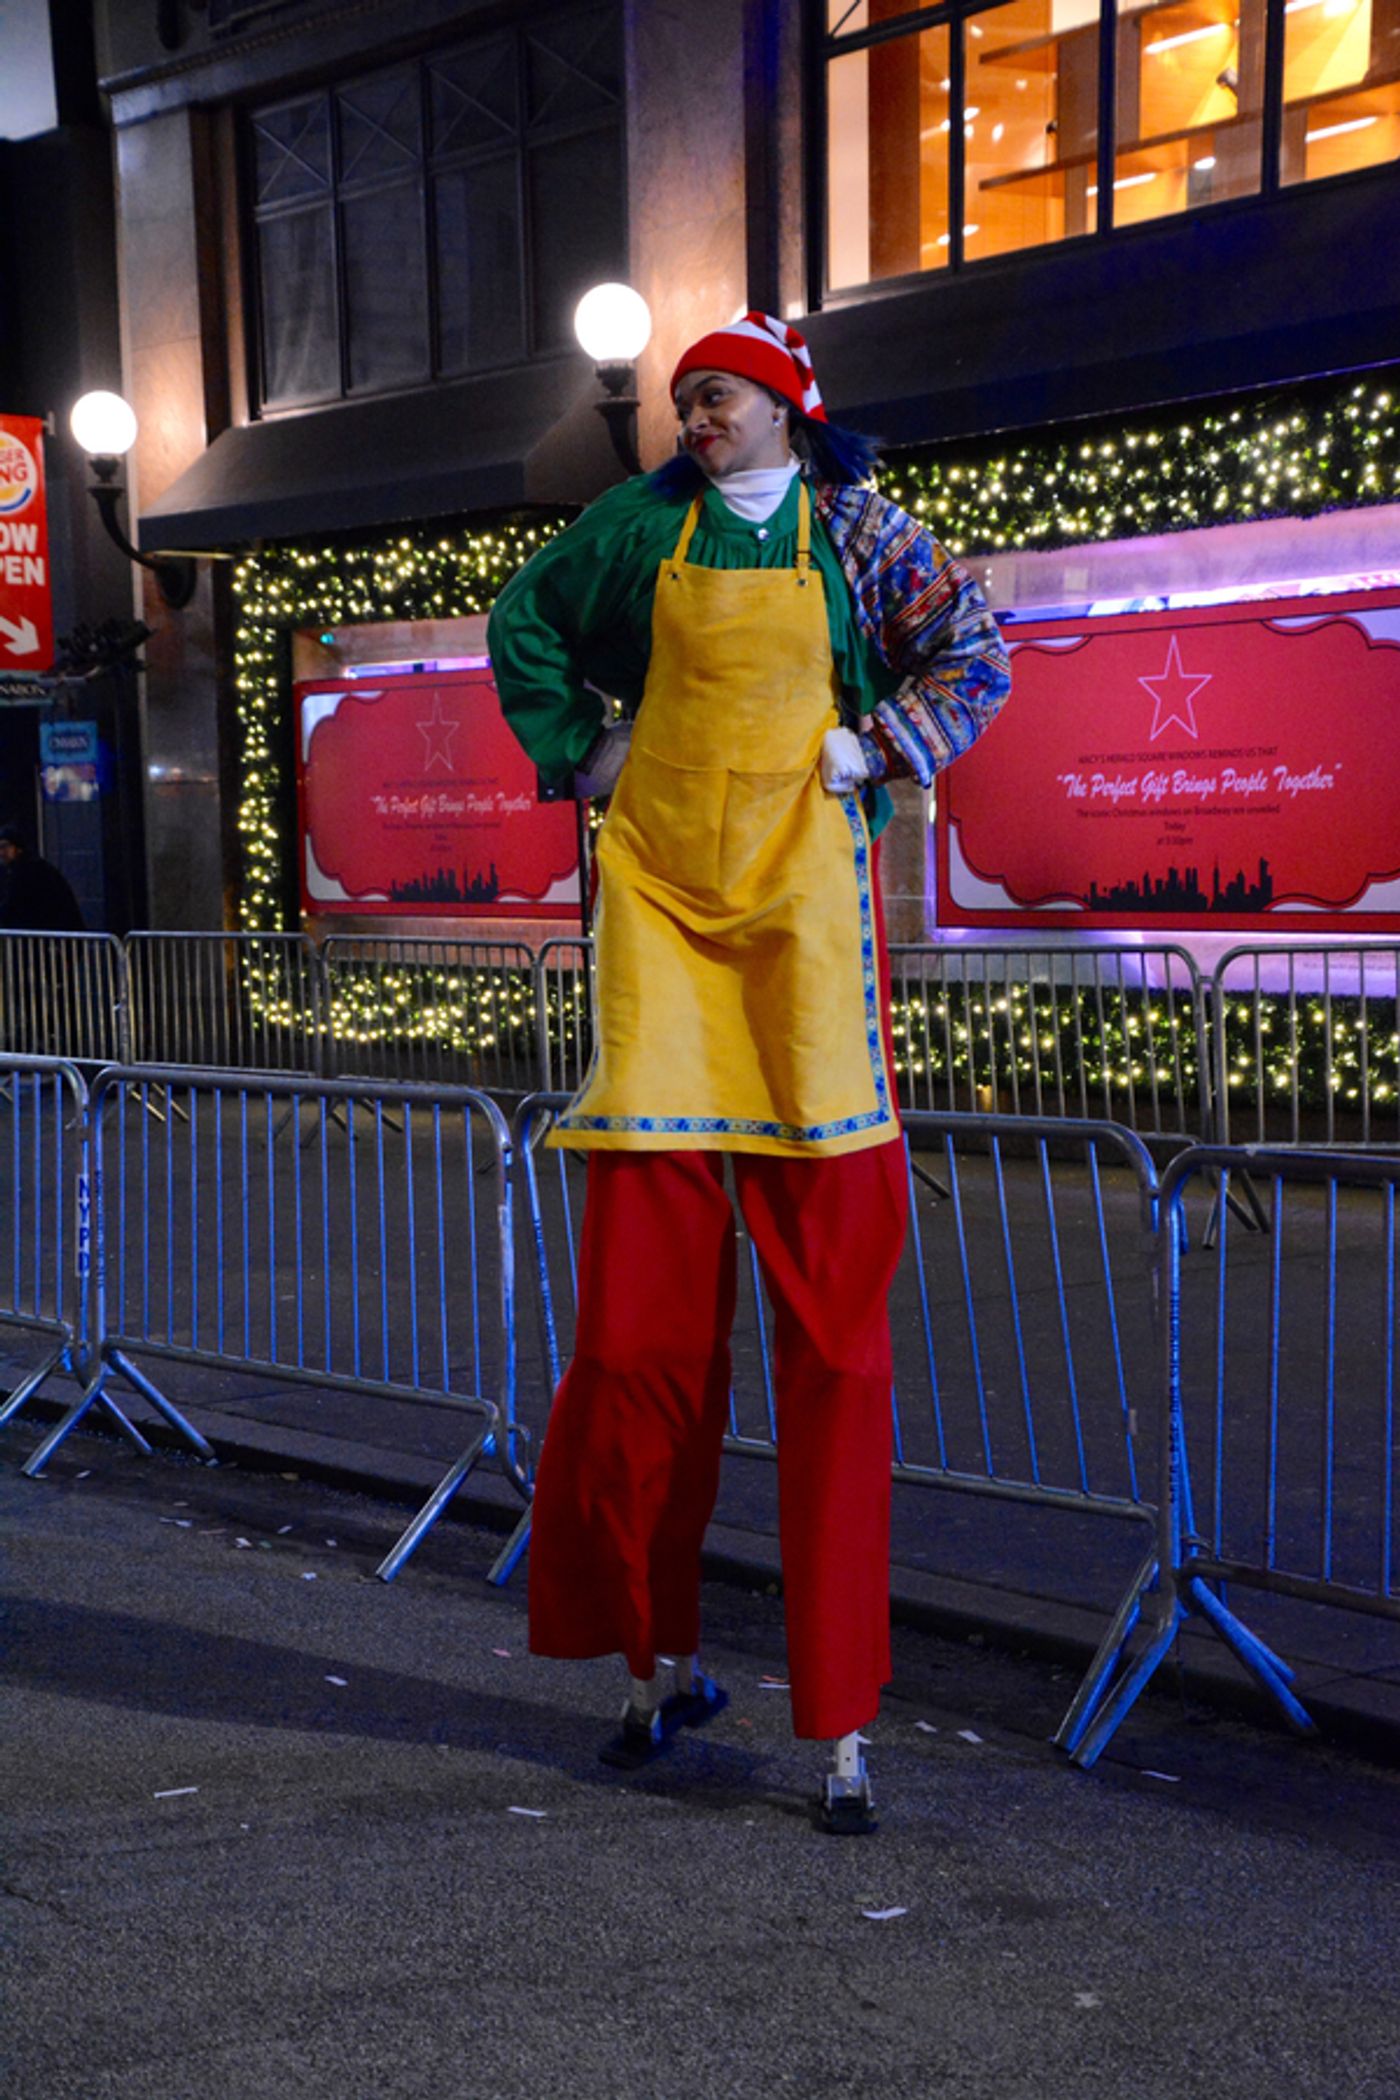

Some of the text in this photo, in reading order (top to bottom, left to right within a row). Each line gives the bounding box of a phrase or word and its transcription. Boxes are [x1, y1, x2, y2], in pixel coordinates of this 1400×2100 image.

[0, 555, 46, 586] EN
[1090, 772, 1138, 804] Perfect
[1141, 770, 1169, 803] Gift
[1172, 769, 1217, 801] Brings
[1220, 767, 1268, 798] People
